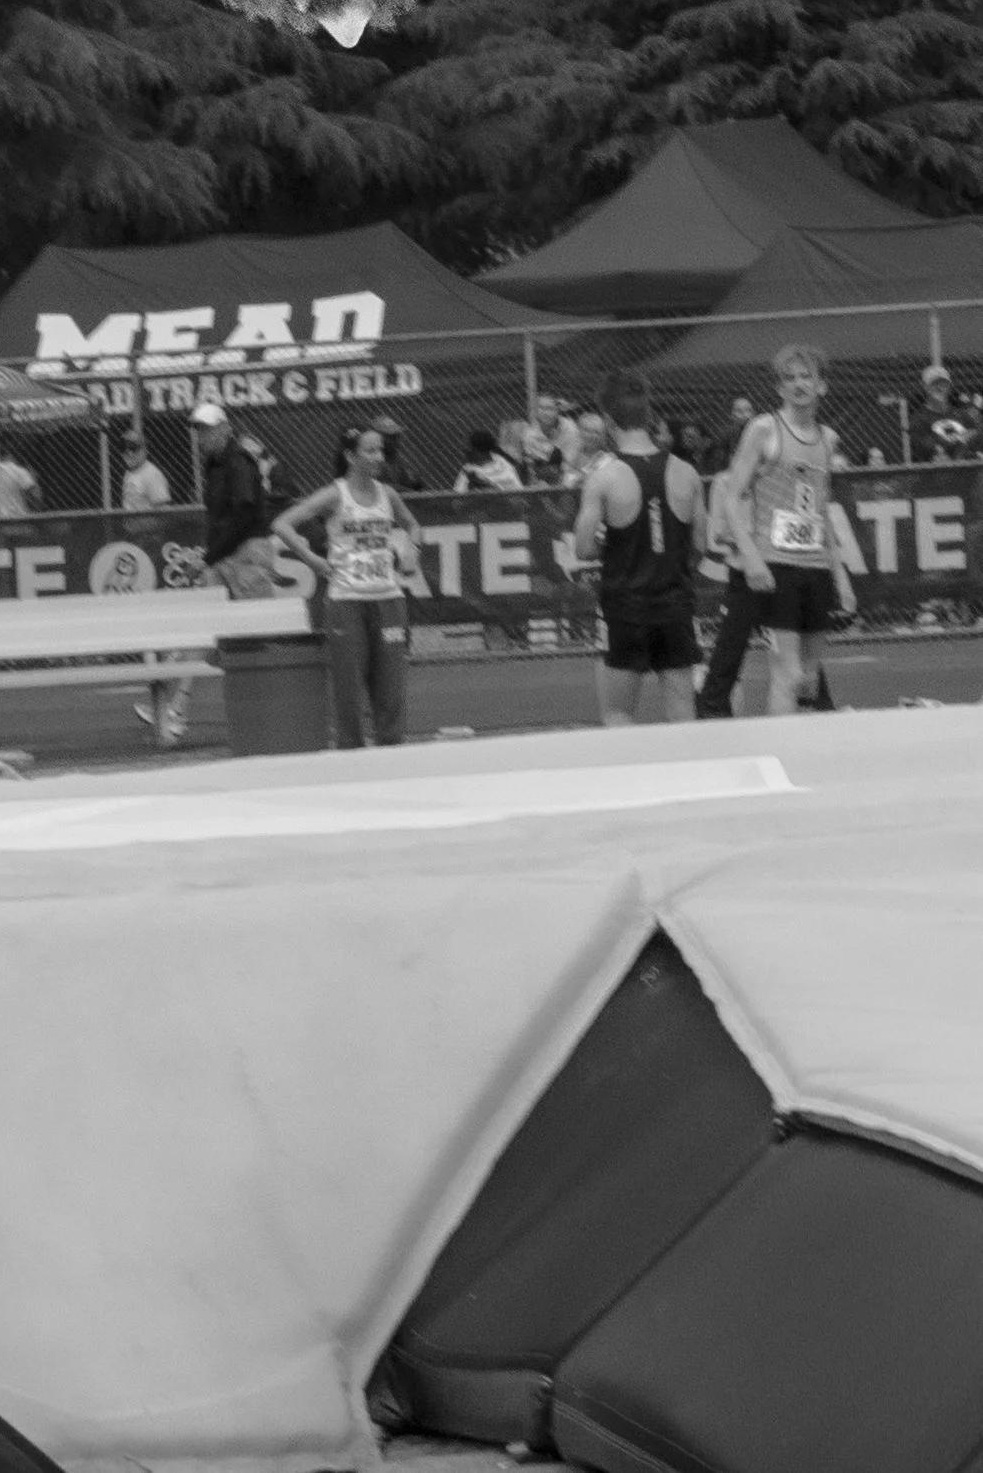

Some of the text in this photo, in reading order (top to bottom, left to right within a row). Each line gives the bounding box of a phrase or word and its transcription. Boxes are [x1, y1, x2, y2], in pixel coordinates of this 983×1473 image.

[25, 291, 385, 379] MEAD
[143, 373, 277, 412] TRACK
[315, 364, 422, 402] FIELD
[825, 496, 967, 575] ATE
